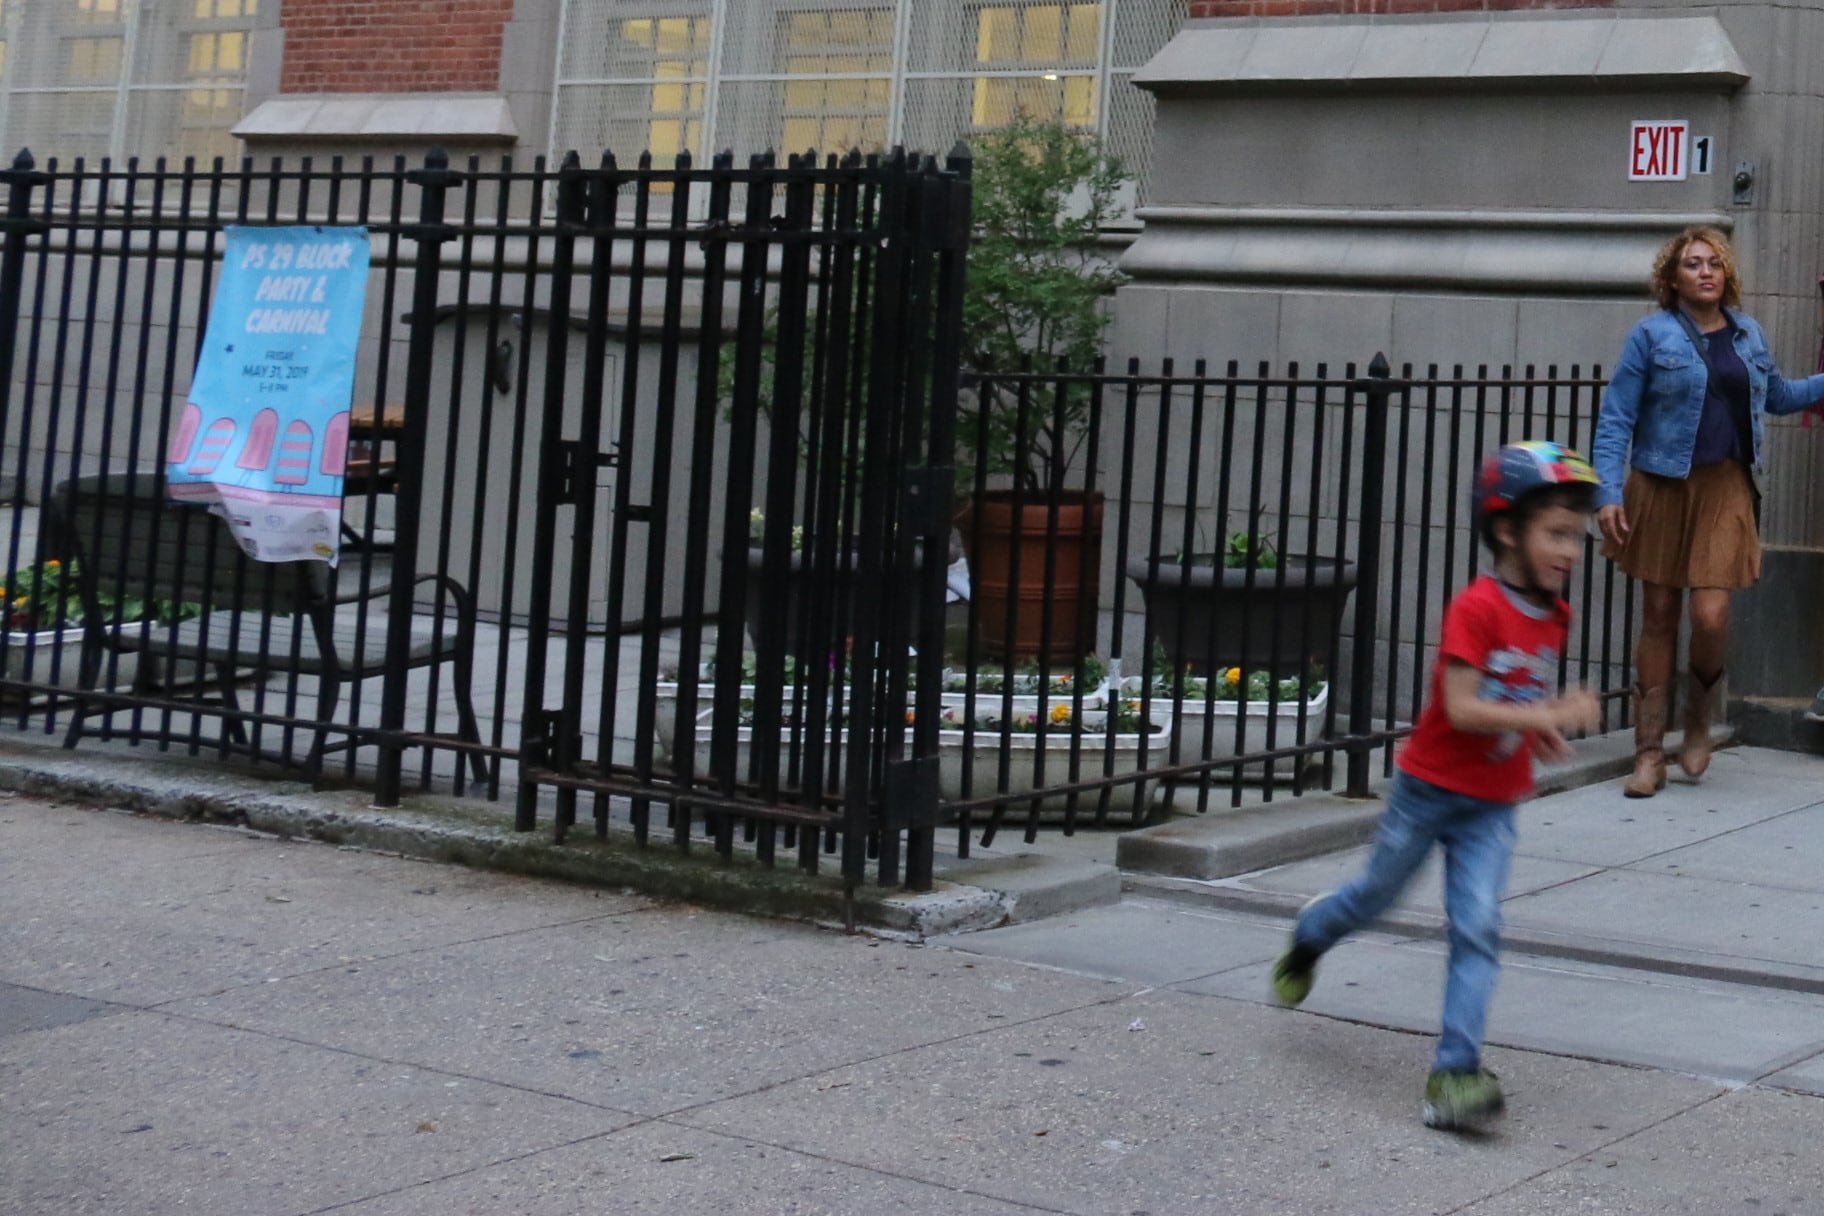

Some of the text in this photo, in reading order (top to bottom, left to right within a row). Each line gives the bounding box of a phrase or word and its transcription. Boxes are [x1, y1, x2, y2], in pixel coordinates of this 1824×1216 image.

[1632, 126, 1684, 175] EXIT
[1697, 137, 1708, 172] 1
[241, 242, 352, 269] PS 29 BLOCK
[255, 275, 328, 302] PARTY &
[245, 309, 331, 334] CARNIVAL
